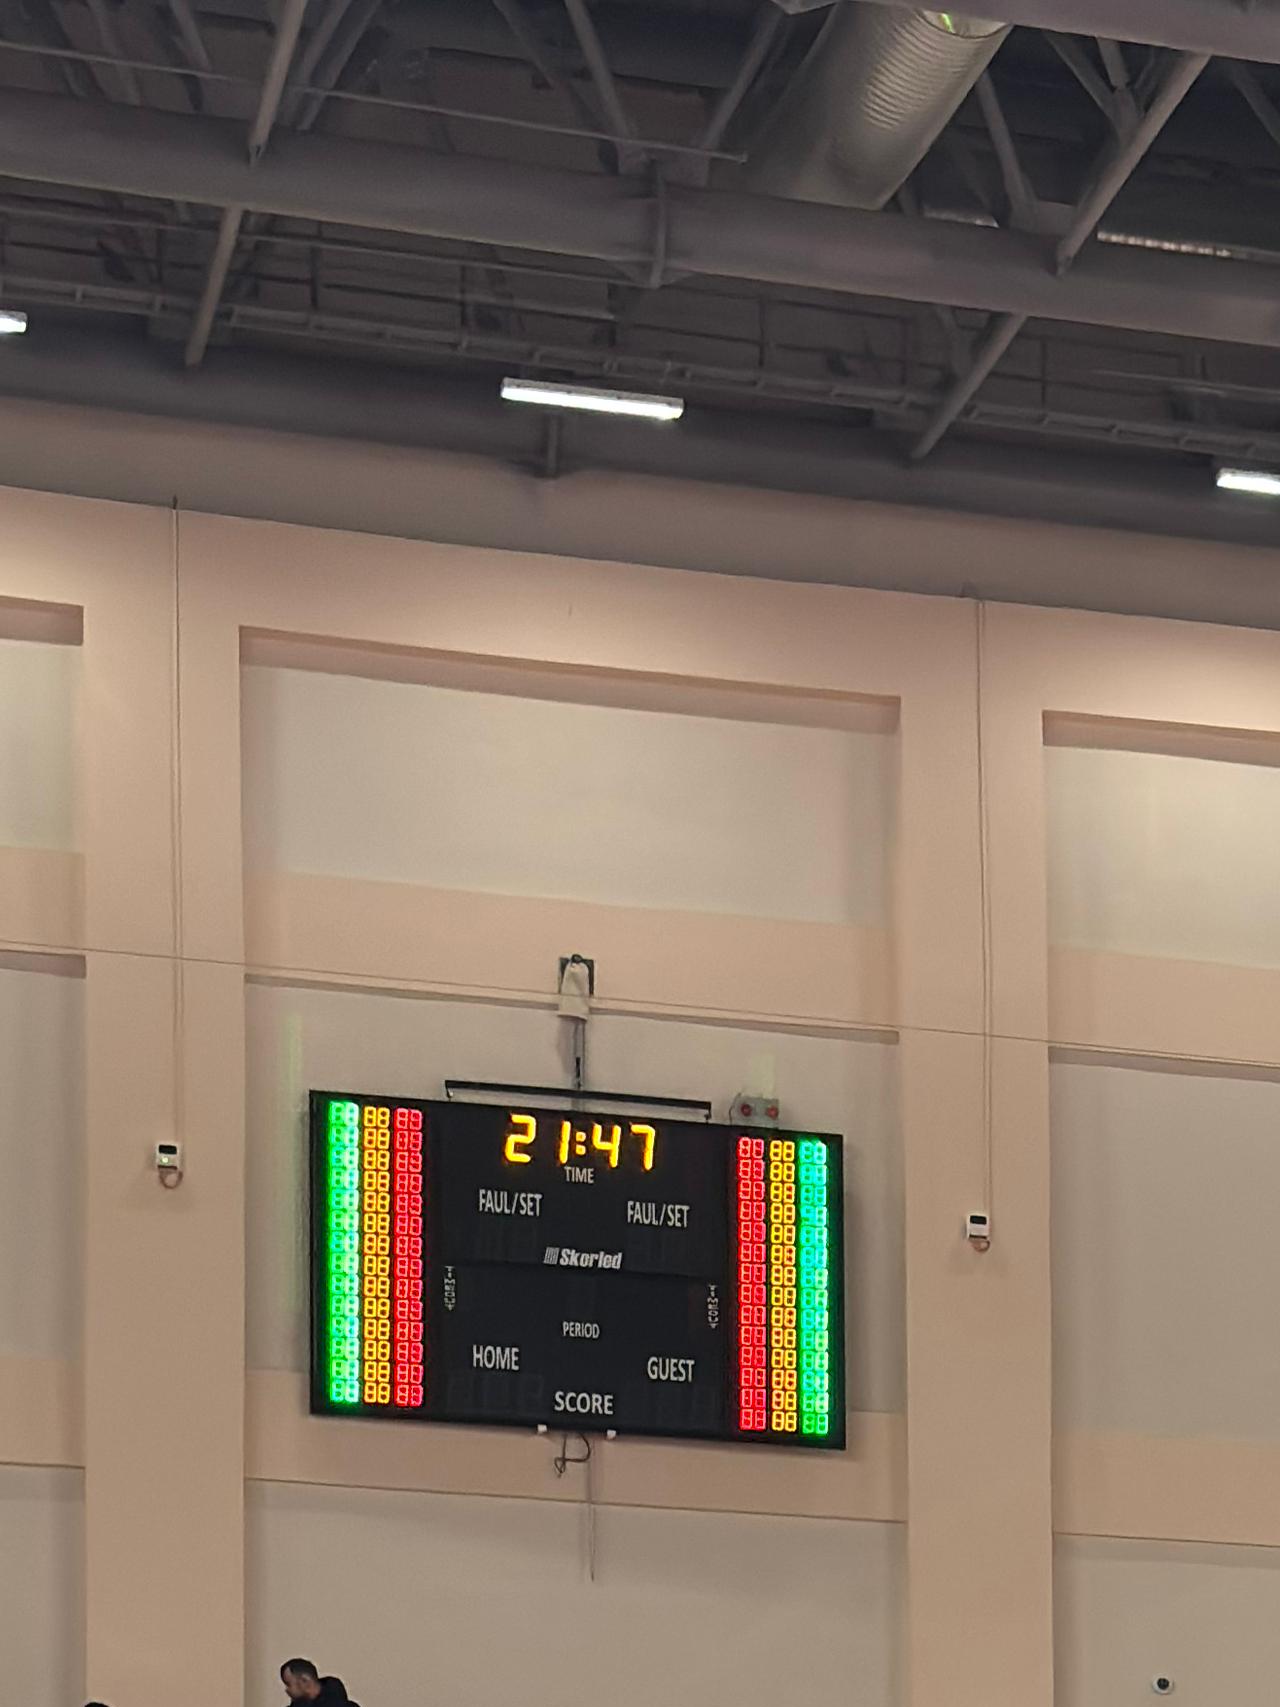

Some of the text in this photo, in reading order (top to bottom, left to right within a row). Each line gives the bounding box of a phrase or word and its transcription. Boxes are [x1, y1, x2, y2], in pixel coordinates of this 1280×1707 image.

[504, 1113, 656, 1172] 21:47
[564, 1166, 594, 1184] TIME
[479, 1189, 542, 1217] FAUL/SET
[627, 1201, 690, 1228] FAUL/SET
[560, 1247, 622, 1270] Skorled
[562, 1321, 600, 1340] PERIOD
[472, 1345, 520, 1371] HOME
[647, 1356, 695, 1383] GUEST
[554, 1391, 614, 1415] SCORE
